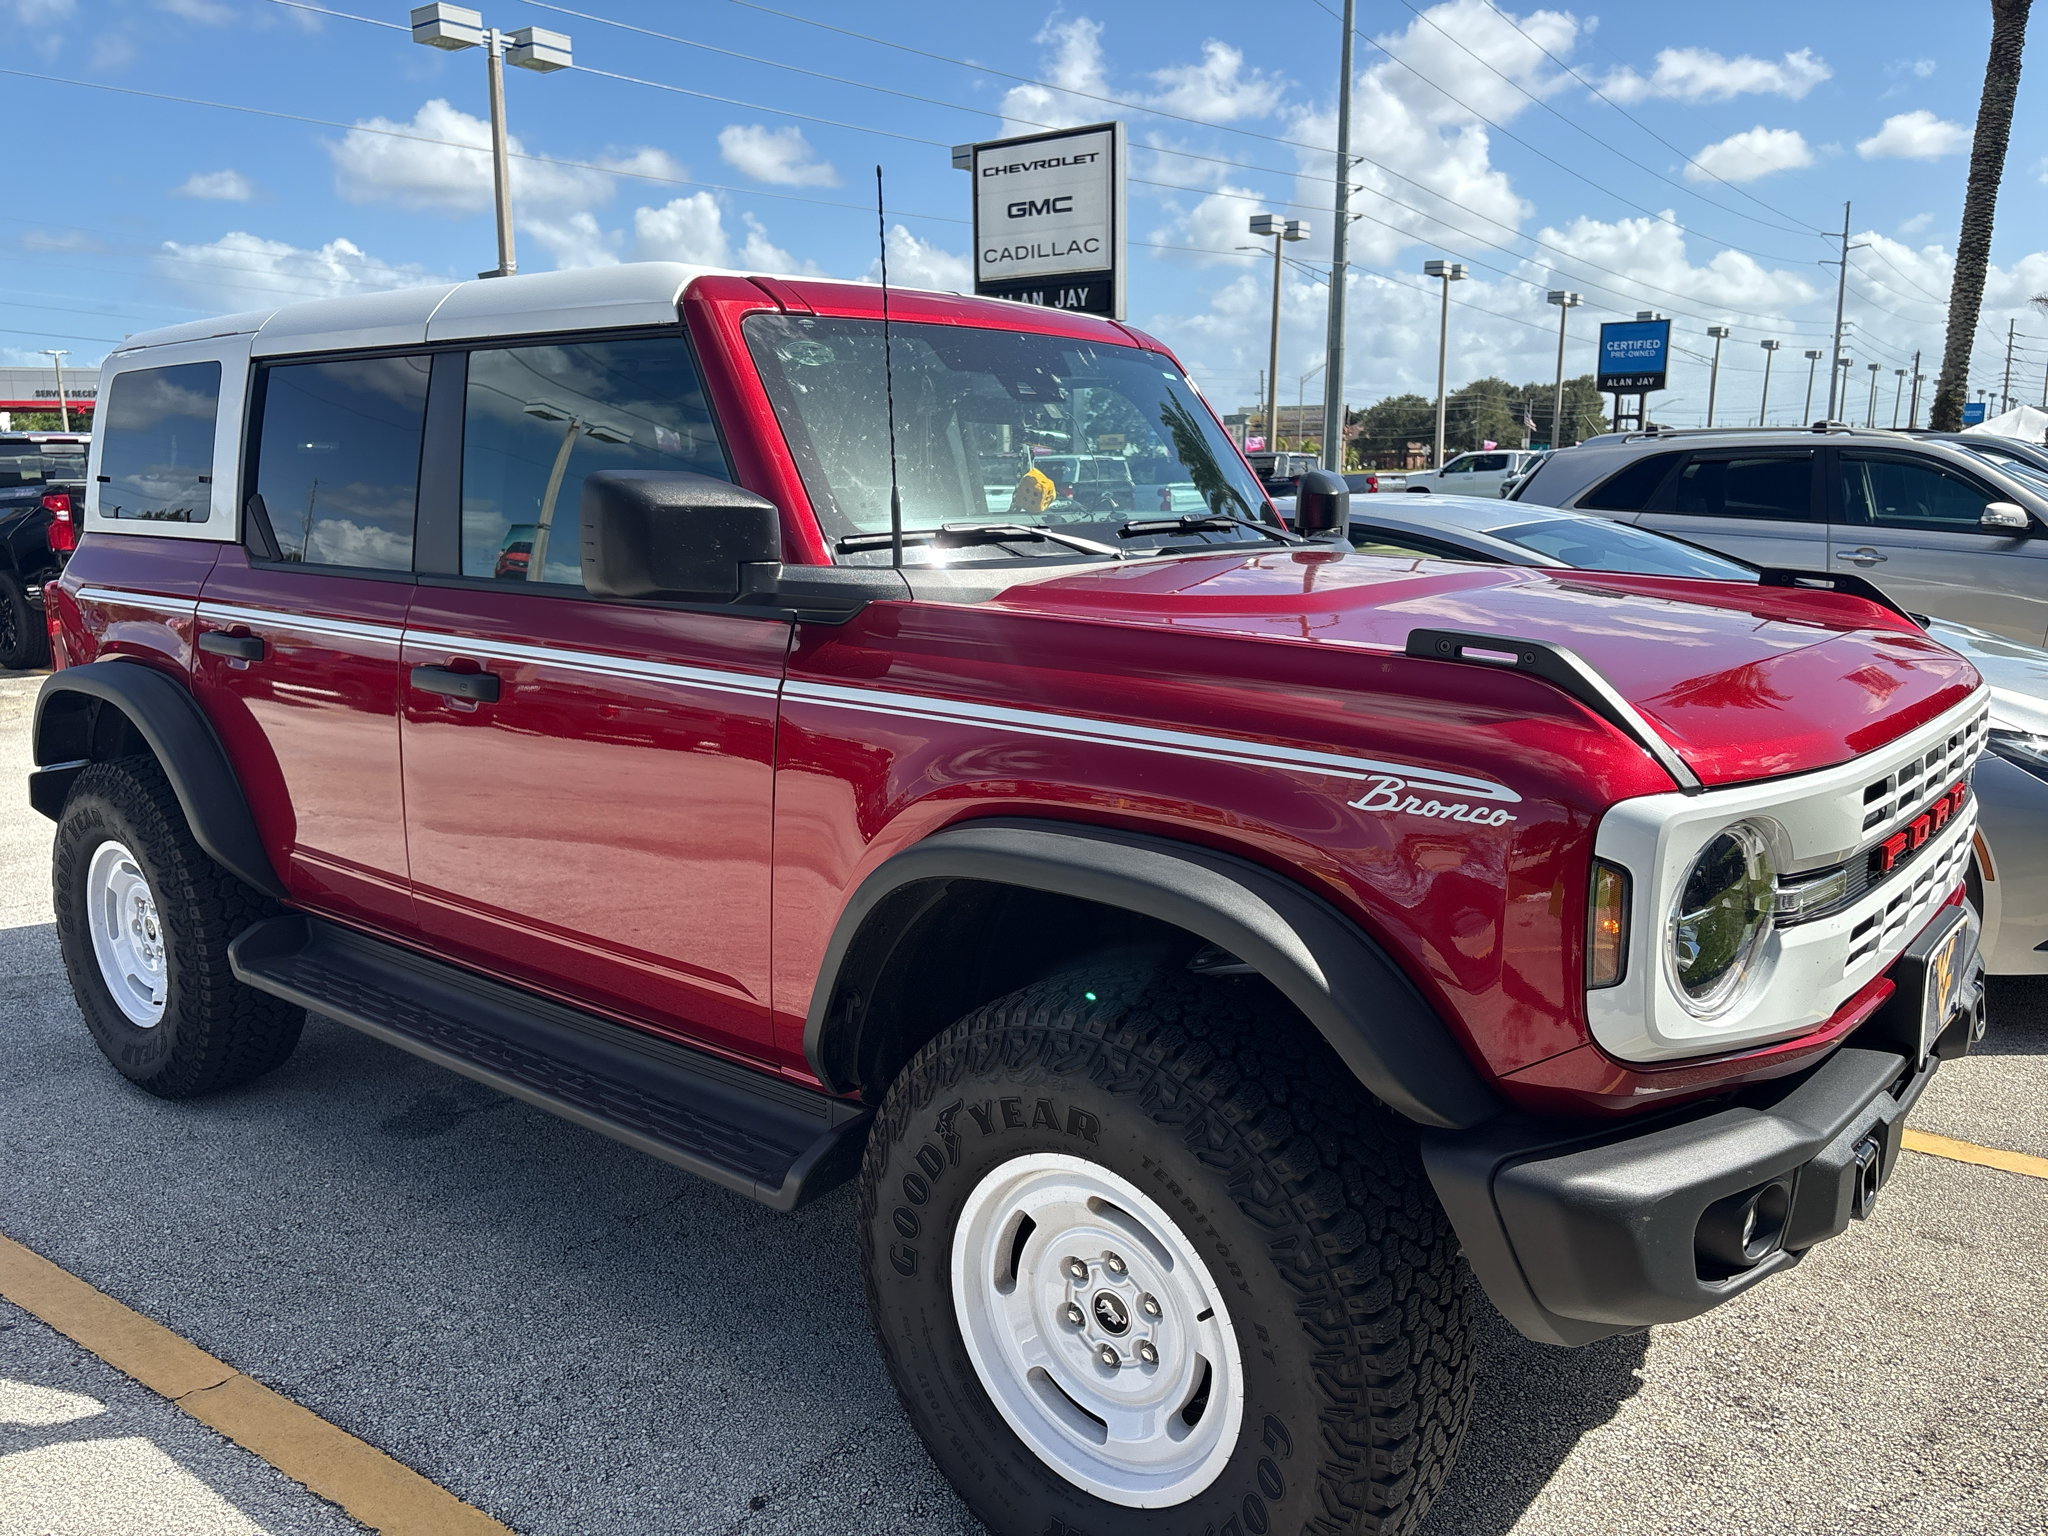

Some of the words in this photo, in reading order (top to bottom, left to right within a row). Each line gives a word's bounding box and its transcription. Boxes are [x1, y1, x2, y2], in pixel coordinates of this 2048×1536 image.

[982, 152, 1100, 178] CHEVROLET
[1007, 195, 1073, 219] GMC
[983, 237, 1100, 264] CADILLAC
[999, 291, 1044, 306] AN
[1054, 287, 1089, 309] JAY
[1606, 339, 1661, 351] CERTIFIED
[1610, 350, 1656, 358] PRE-OWNED
[35, 389, 70, 398] SERVIE
[1606, 378, 1632, 387] ALAN
[1636, 376, 1655, 386] JAY
[1347, 775, 1518, 827] Bronco
[1880, 781, 1966, 872] FORD
[889, 1096, 1101, 1278] GOODYEAR
[1141, 1154, 1255, 1299] TERRITORY
